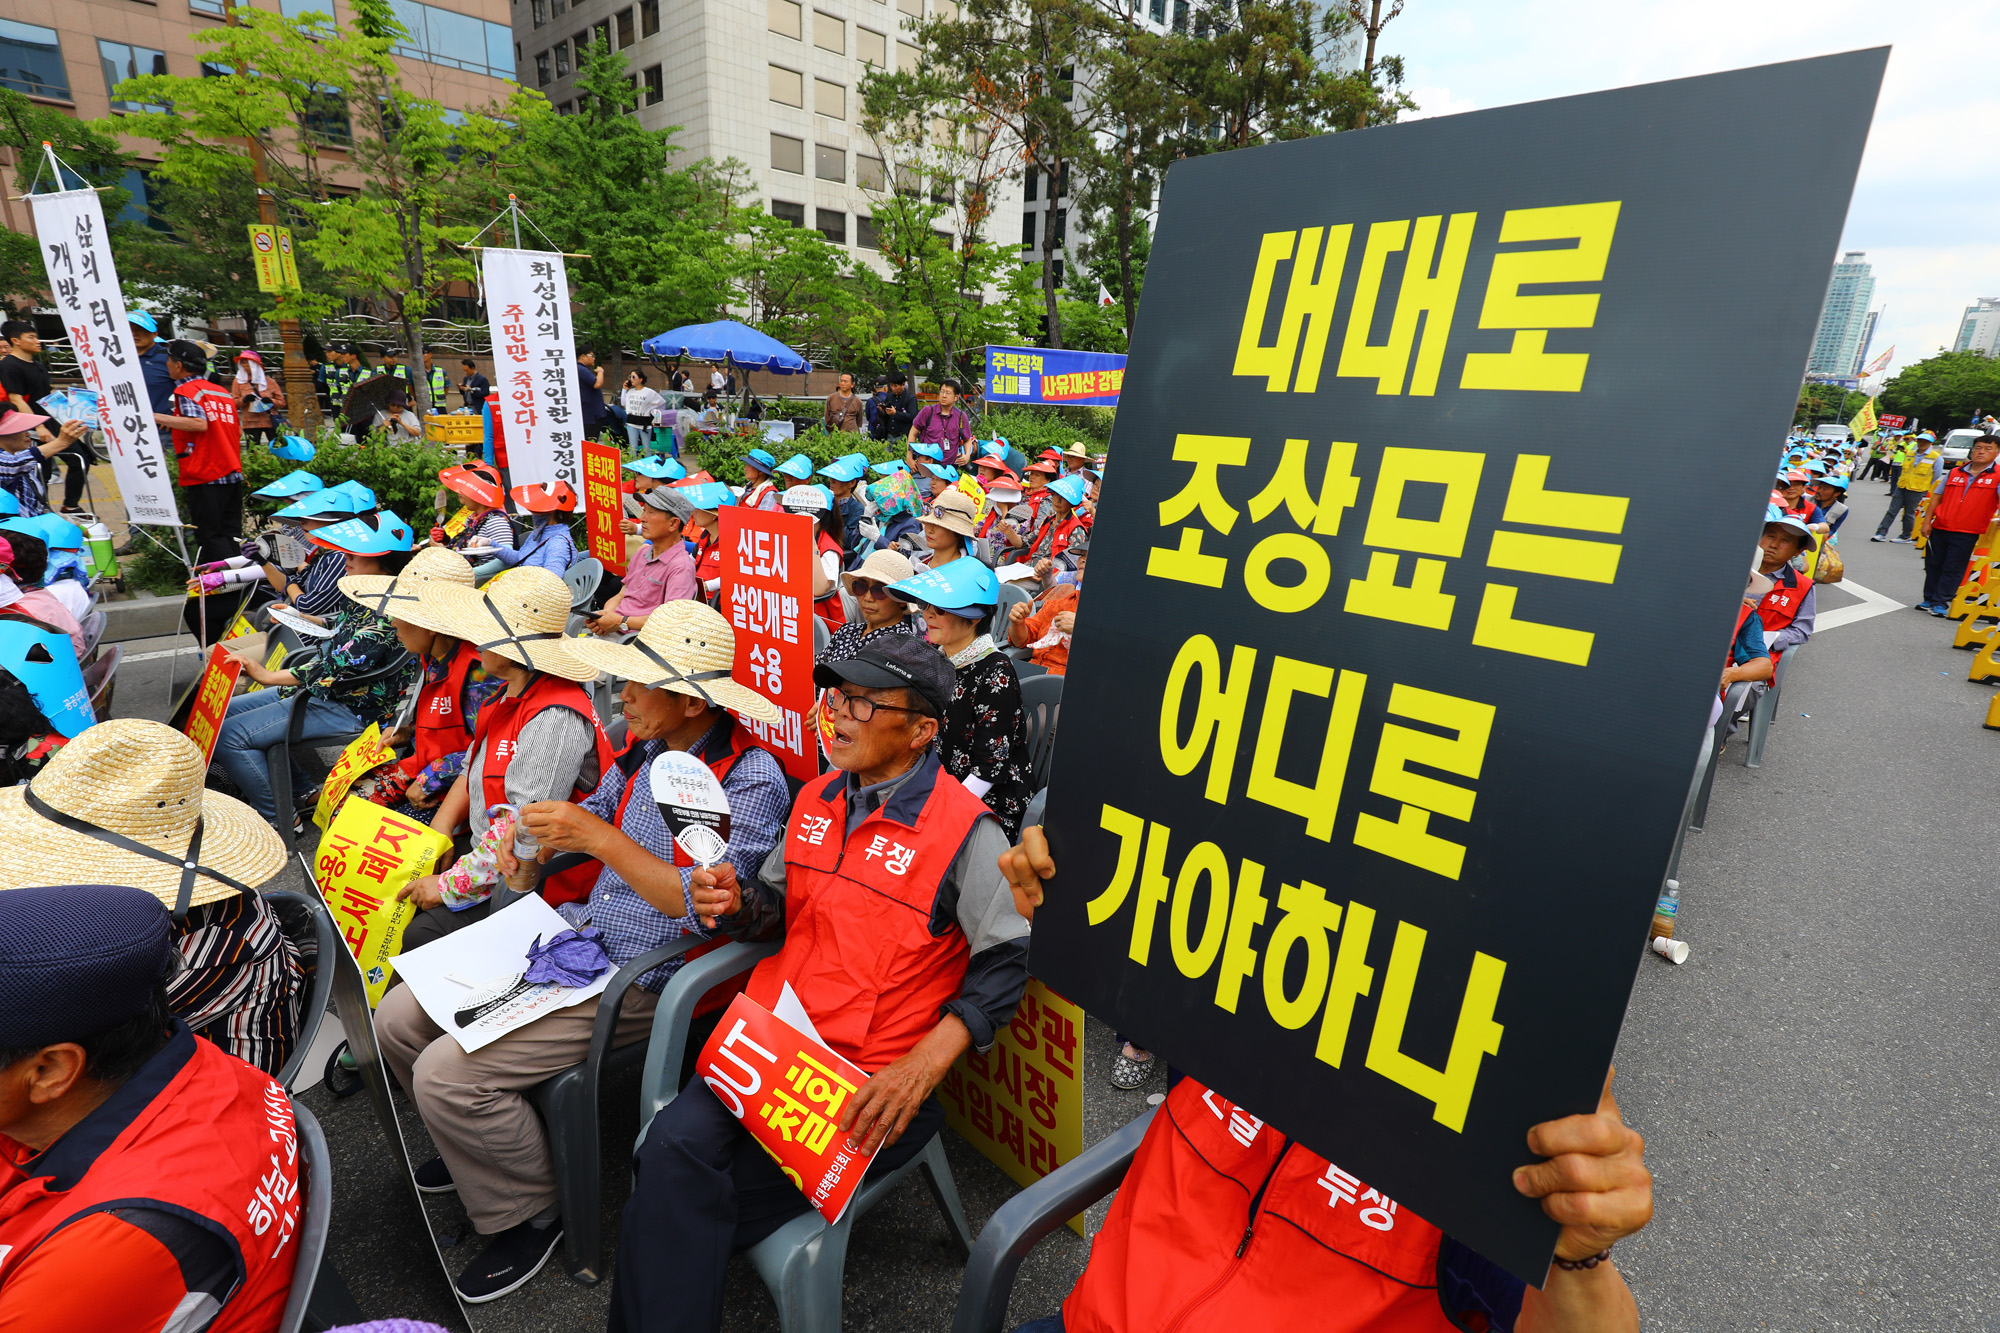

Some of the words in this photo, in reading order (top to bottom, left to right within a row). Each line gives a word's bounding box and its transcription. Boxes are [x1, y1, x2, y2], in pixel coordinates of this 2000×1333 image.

[49, 242, 81, 310] 개발
[530, 261, 560, 341] 화성시의
[1232, 201, 1622, 397] 대대로
[74, 214, 99, 284] 삶의
[89, 298, 125, 367] 터전
[111, 381, 158, 478] 빼앗는
[501, 304, 529, 363] 주민만
[540, 348, 573, 424] 무책임한
[992, 352, 1044, 375] 주택정책
[992, 374, 1031, 396] 실패를
[1042, 372, 1096, 397] 사유재산
[1098, 368, 1124, 391] 강탈
[509, 370, 538, 444] 죽인다!
[549, 431, 577, 485] 행정이
[586, 452, 616, 483] 졸속지정
[588, 480, 618, 511] 주택정책
[596, 509, 612, 536] 개가
[595, 535, 617, 563] 웃는다
[737, 528, 788, 583] 신도시
[1146, 434, 1630, 667] 조상묘는
[731, 583, 799, 645] 살인개발
[750, 644, 783, 695] 수용
[885, 661, 907, 676] Lafuma
[1160, 634, 1496, 881] 어디로
[356, 816, 423, 884] 폐지
[864, 833, 916, 875] 투쟁
[376, 926, 398, 963] 공공주택지구
[1087, 804, 1507, 1134] 가야하나
[704, 1018, 778, 1119] OUT
[758, 1050, 859, 1156] 철회
[815, 1151, 852, 1200] 대책협의회
[1316, 1162, 1398, 1232] 투쟁
